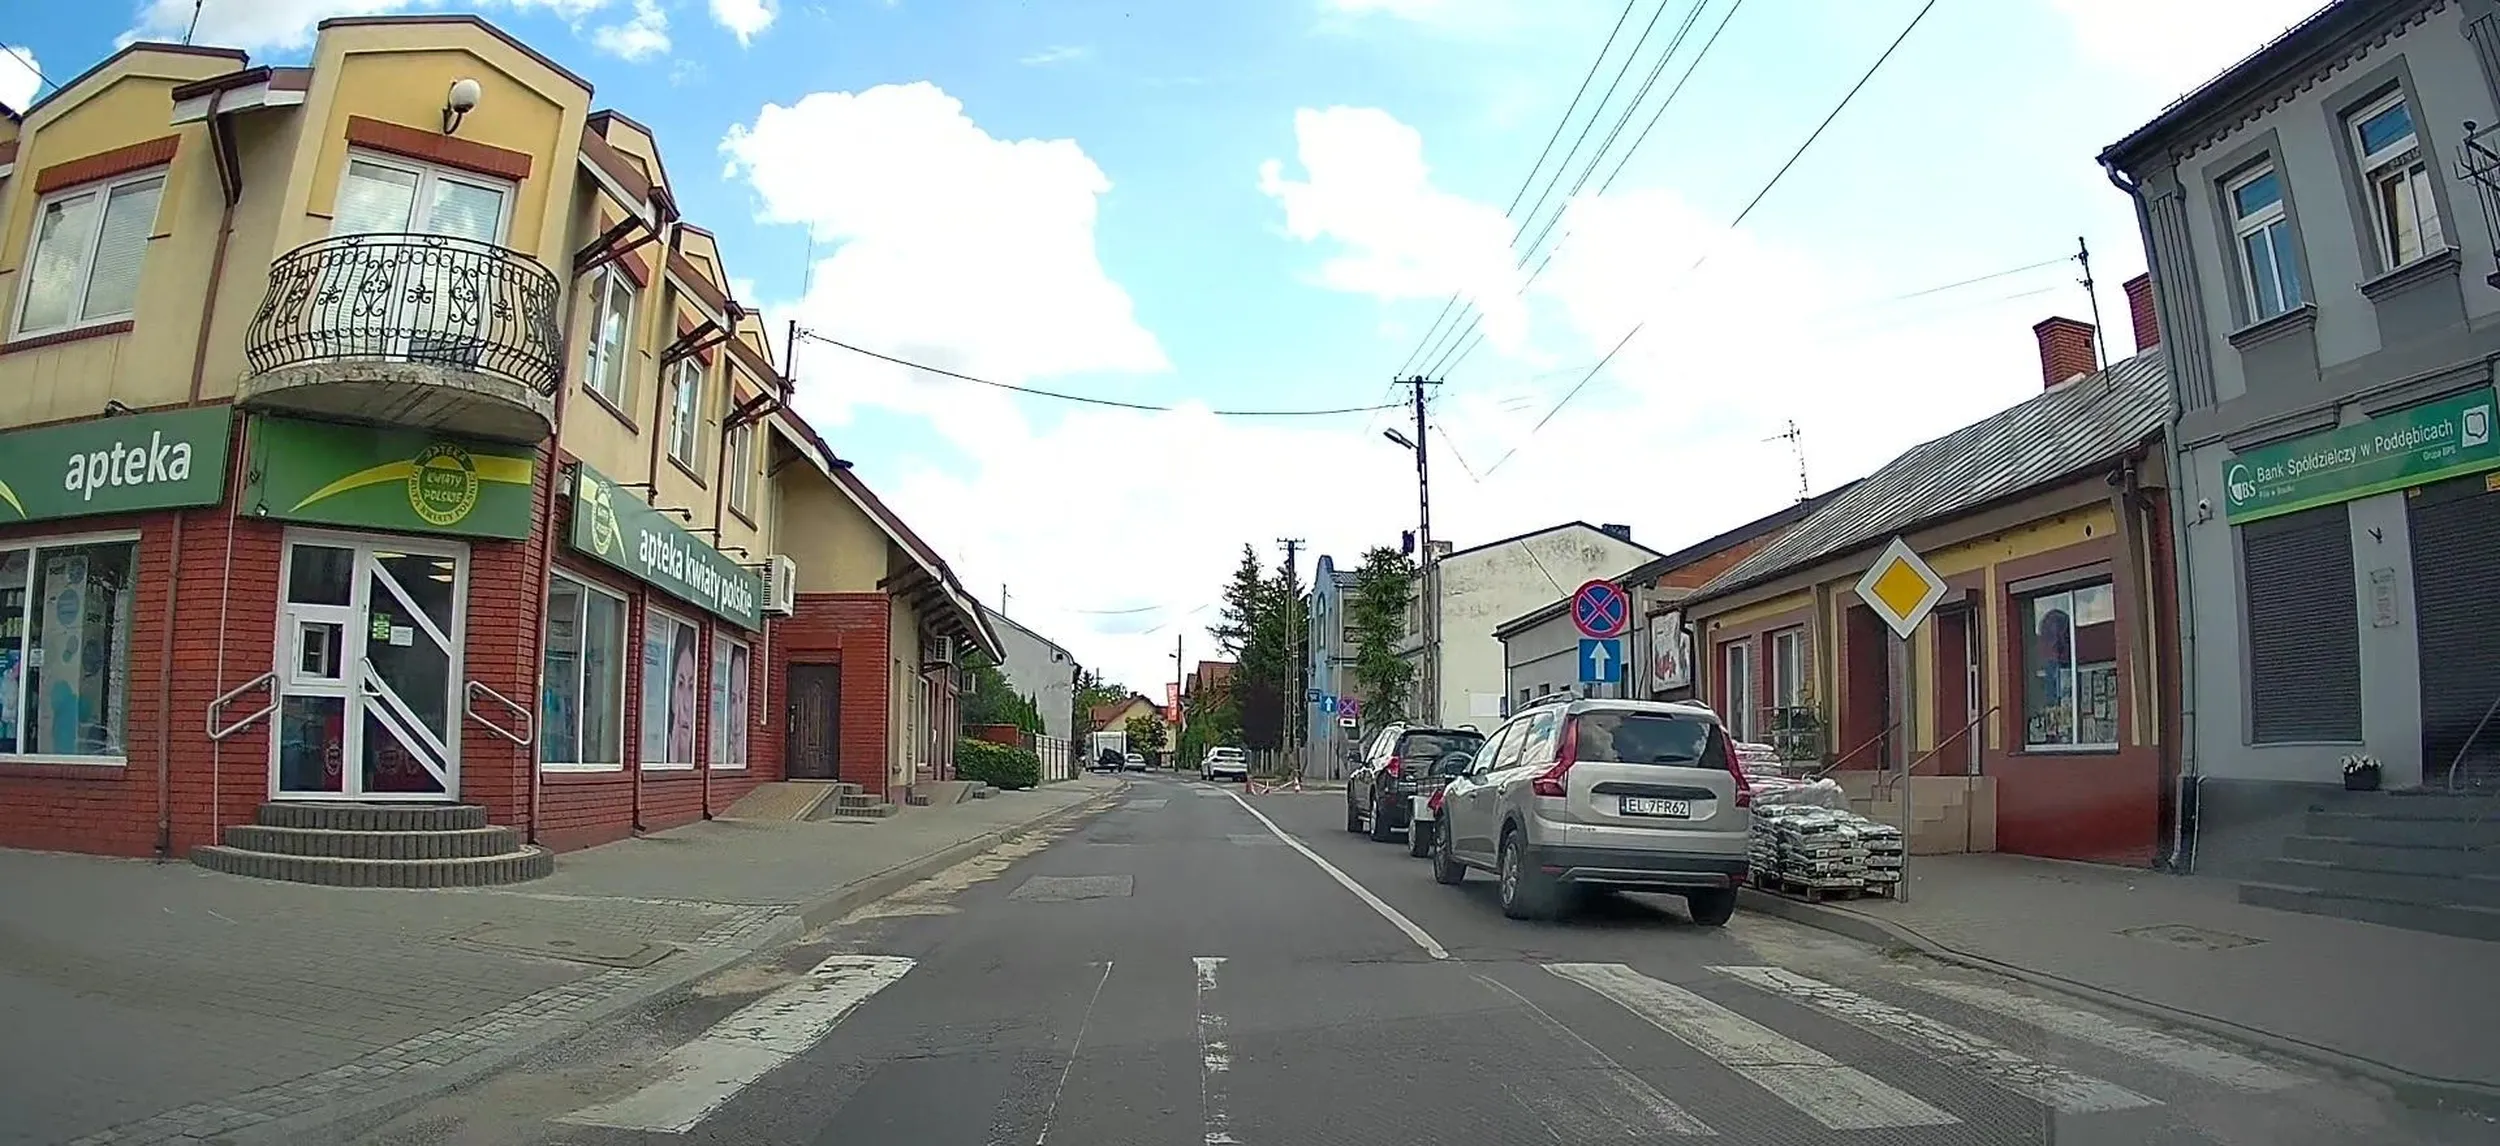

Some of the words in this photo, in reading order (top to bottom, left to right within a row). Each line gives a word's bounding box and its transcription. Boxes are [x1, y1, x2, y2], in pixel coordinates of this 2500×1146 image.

[64, 430, 192, 501] apteka
[2257, 462, 2285, 482] Bank
[2287, 446, 2357, 476] Spółdzielczy
[2360, 443, 2371, 456] w
[2374, 418, 2454, 450] Poddębicach
[423, 489, 463, 503] POLSKIE
[427, 472, 462, 488] KWIATY
[639, 528, 683, 580] apteka
[685, 543, 721, 609] kwiaty
[721, 574, 753, 618] polskie
[1628, 798, 1645, 812] EL
[1648, 800, 1687, 815] 7FR62
